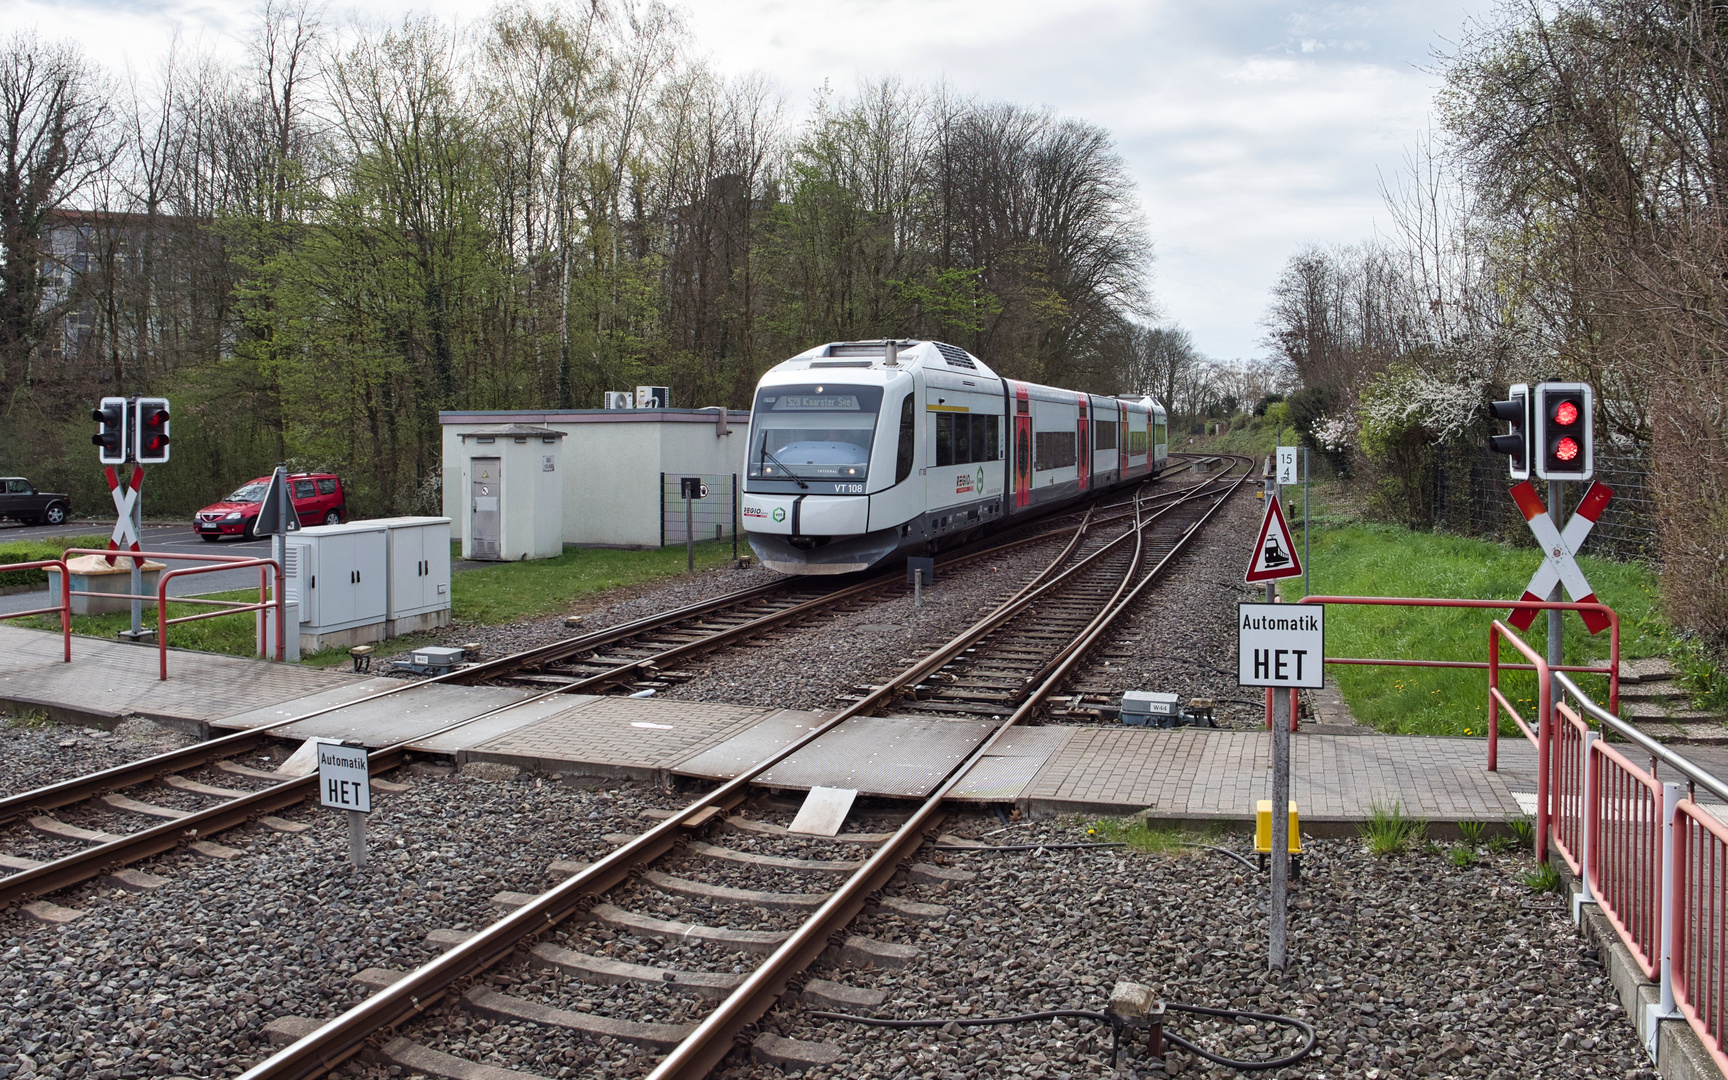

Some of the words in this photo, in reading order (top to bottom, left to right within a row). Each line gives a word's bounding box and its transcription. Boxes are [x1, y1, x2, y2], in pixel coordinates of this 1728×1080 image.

[788, 397, 800, 407] S28
[803, 397, 835, 407] Kaarster
[837, 397, 851, 407] See
[1281, 453, 1292, 464] 15
[1283, 466, 1290, 478] 4
[834, 484, 847, 493] VT
[848, 484, 863, 493] 108
[1242, 614, 1319, 632] Automatik
[1254, 648, 1308, 681] HET
[321, 752, 366, 770] Automatik
[328, 778, 361, 806] HET
